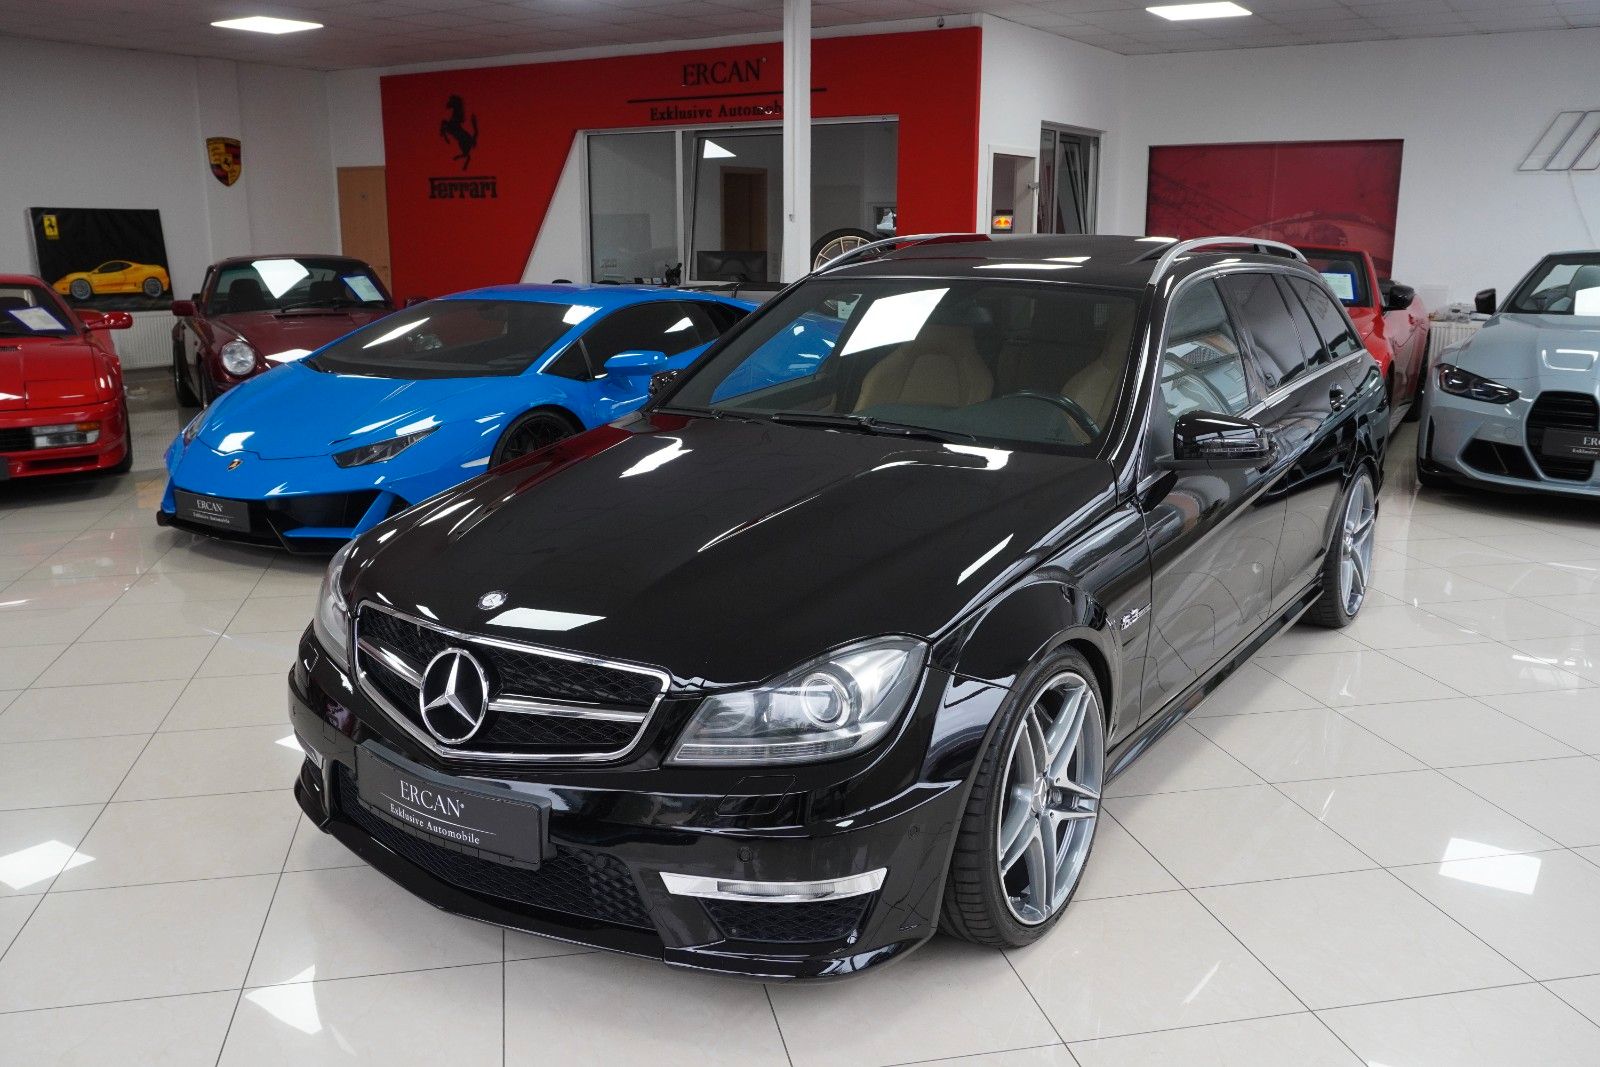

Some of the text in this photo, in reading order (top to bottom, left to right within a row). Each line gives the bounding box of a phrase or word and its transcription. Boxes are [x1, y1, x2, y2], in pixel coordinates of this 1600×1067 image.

[682, 59, 762, 87] ERCAN
[651, 100, 783, 121] Exklusive Automob
[429, 176, 497, 199] Ferrari
[400, 780, 460, 818] ERCAN
[390, 803, 480, 845] Exklusive Automobile
